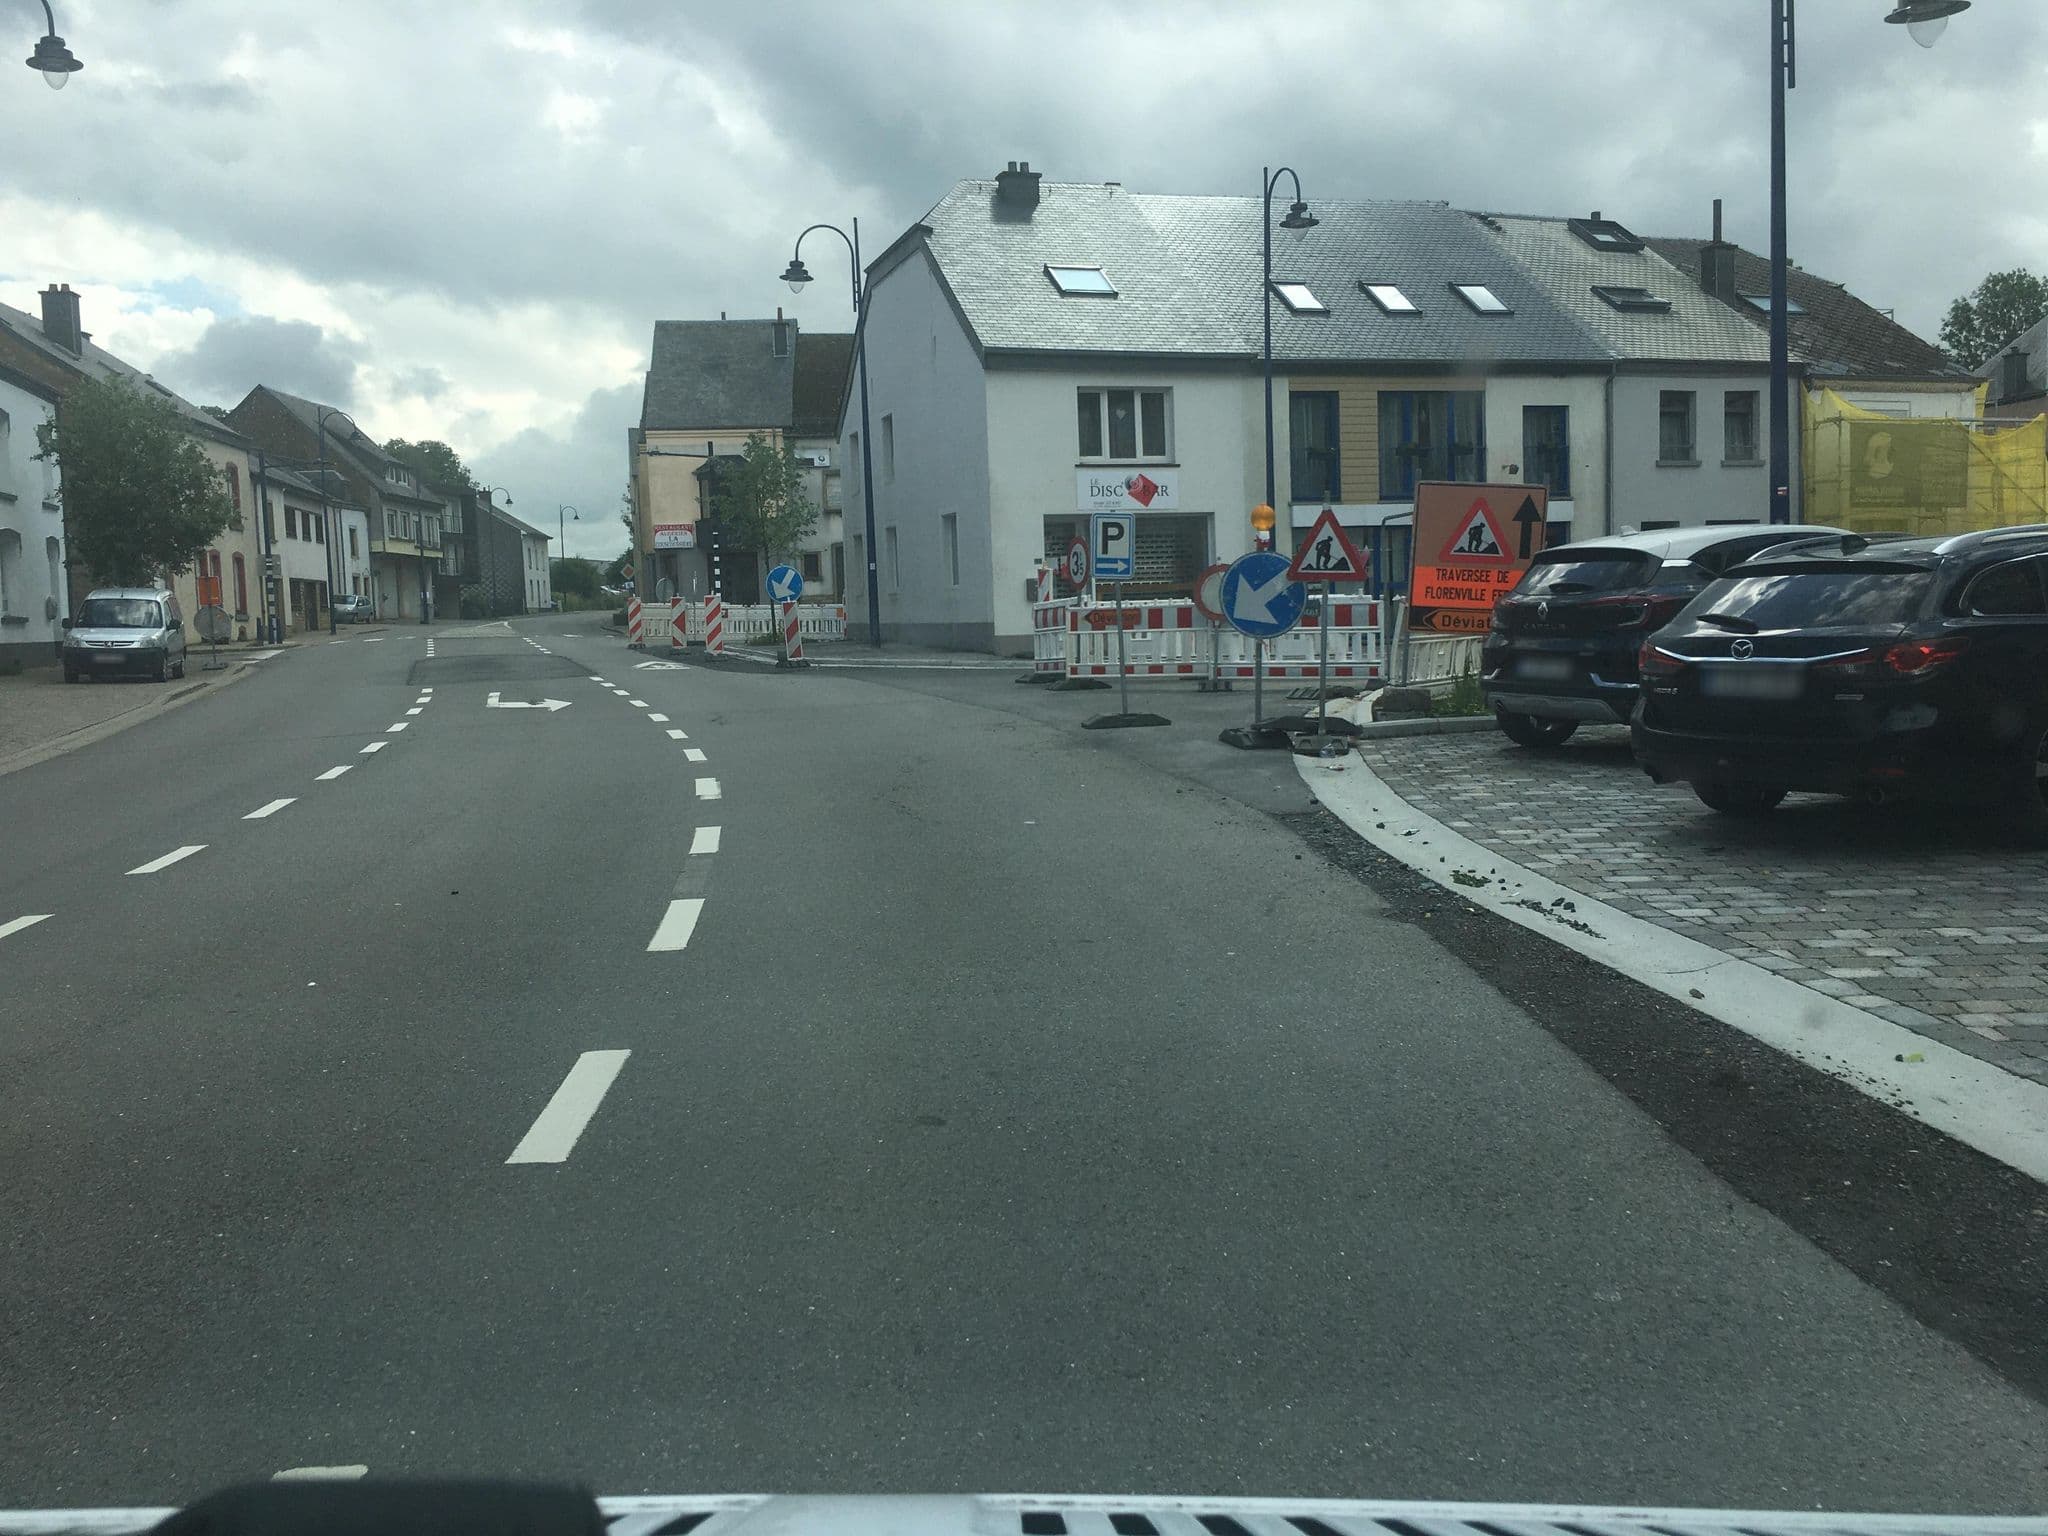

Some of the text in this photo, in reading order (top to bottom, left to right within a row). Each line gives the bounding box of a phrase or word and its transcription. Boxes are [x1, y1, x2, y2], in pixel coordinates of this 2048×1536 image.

[1101, 522, 1125, 555] P
[1436, 568, 1510, 584] TRAVERSEE DE
[1425, 586, 1486, 601] FLORENVILLE
[1441, 614, 1490, 628] Déviat
